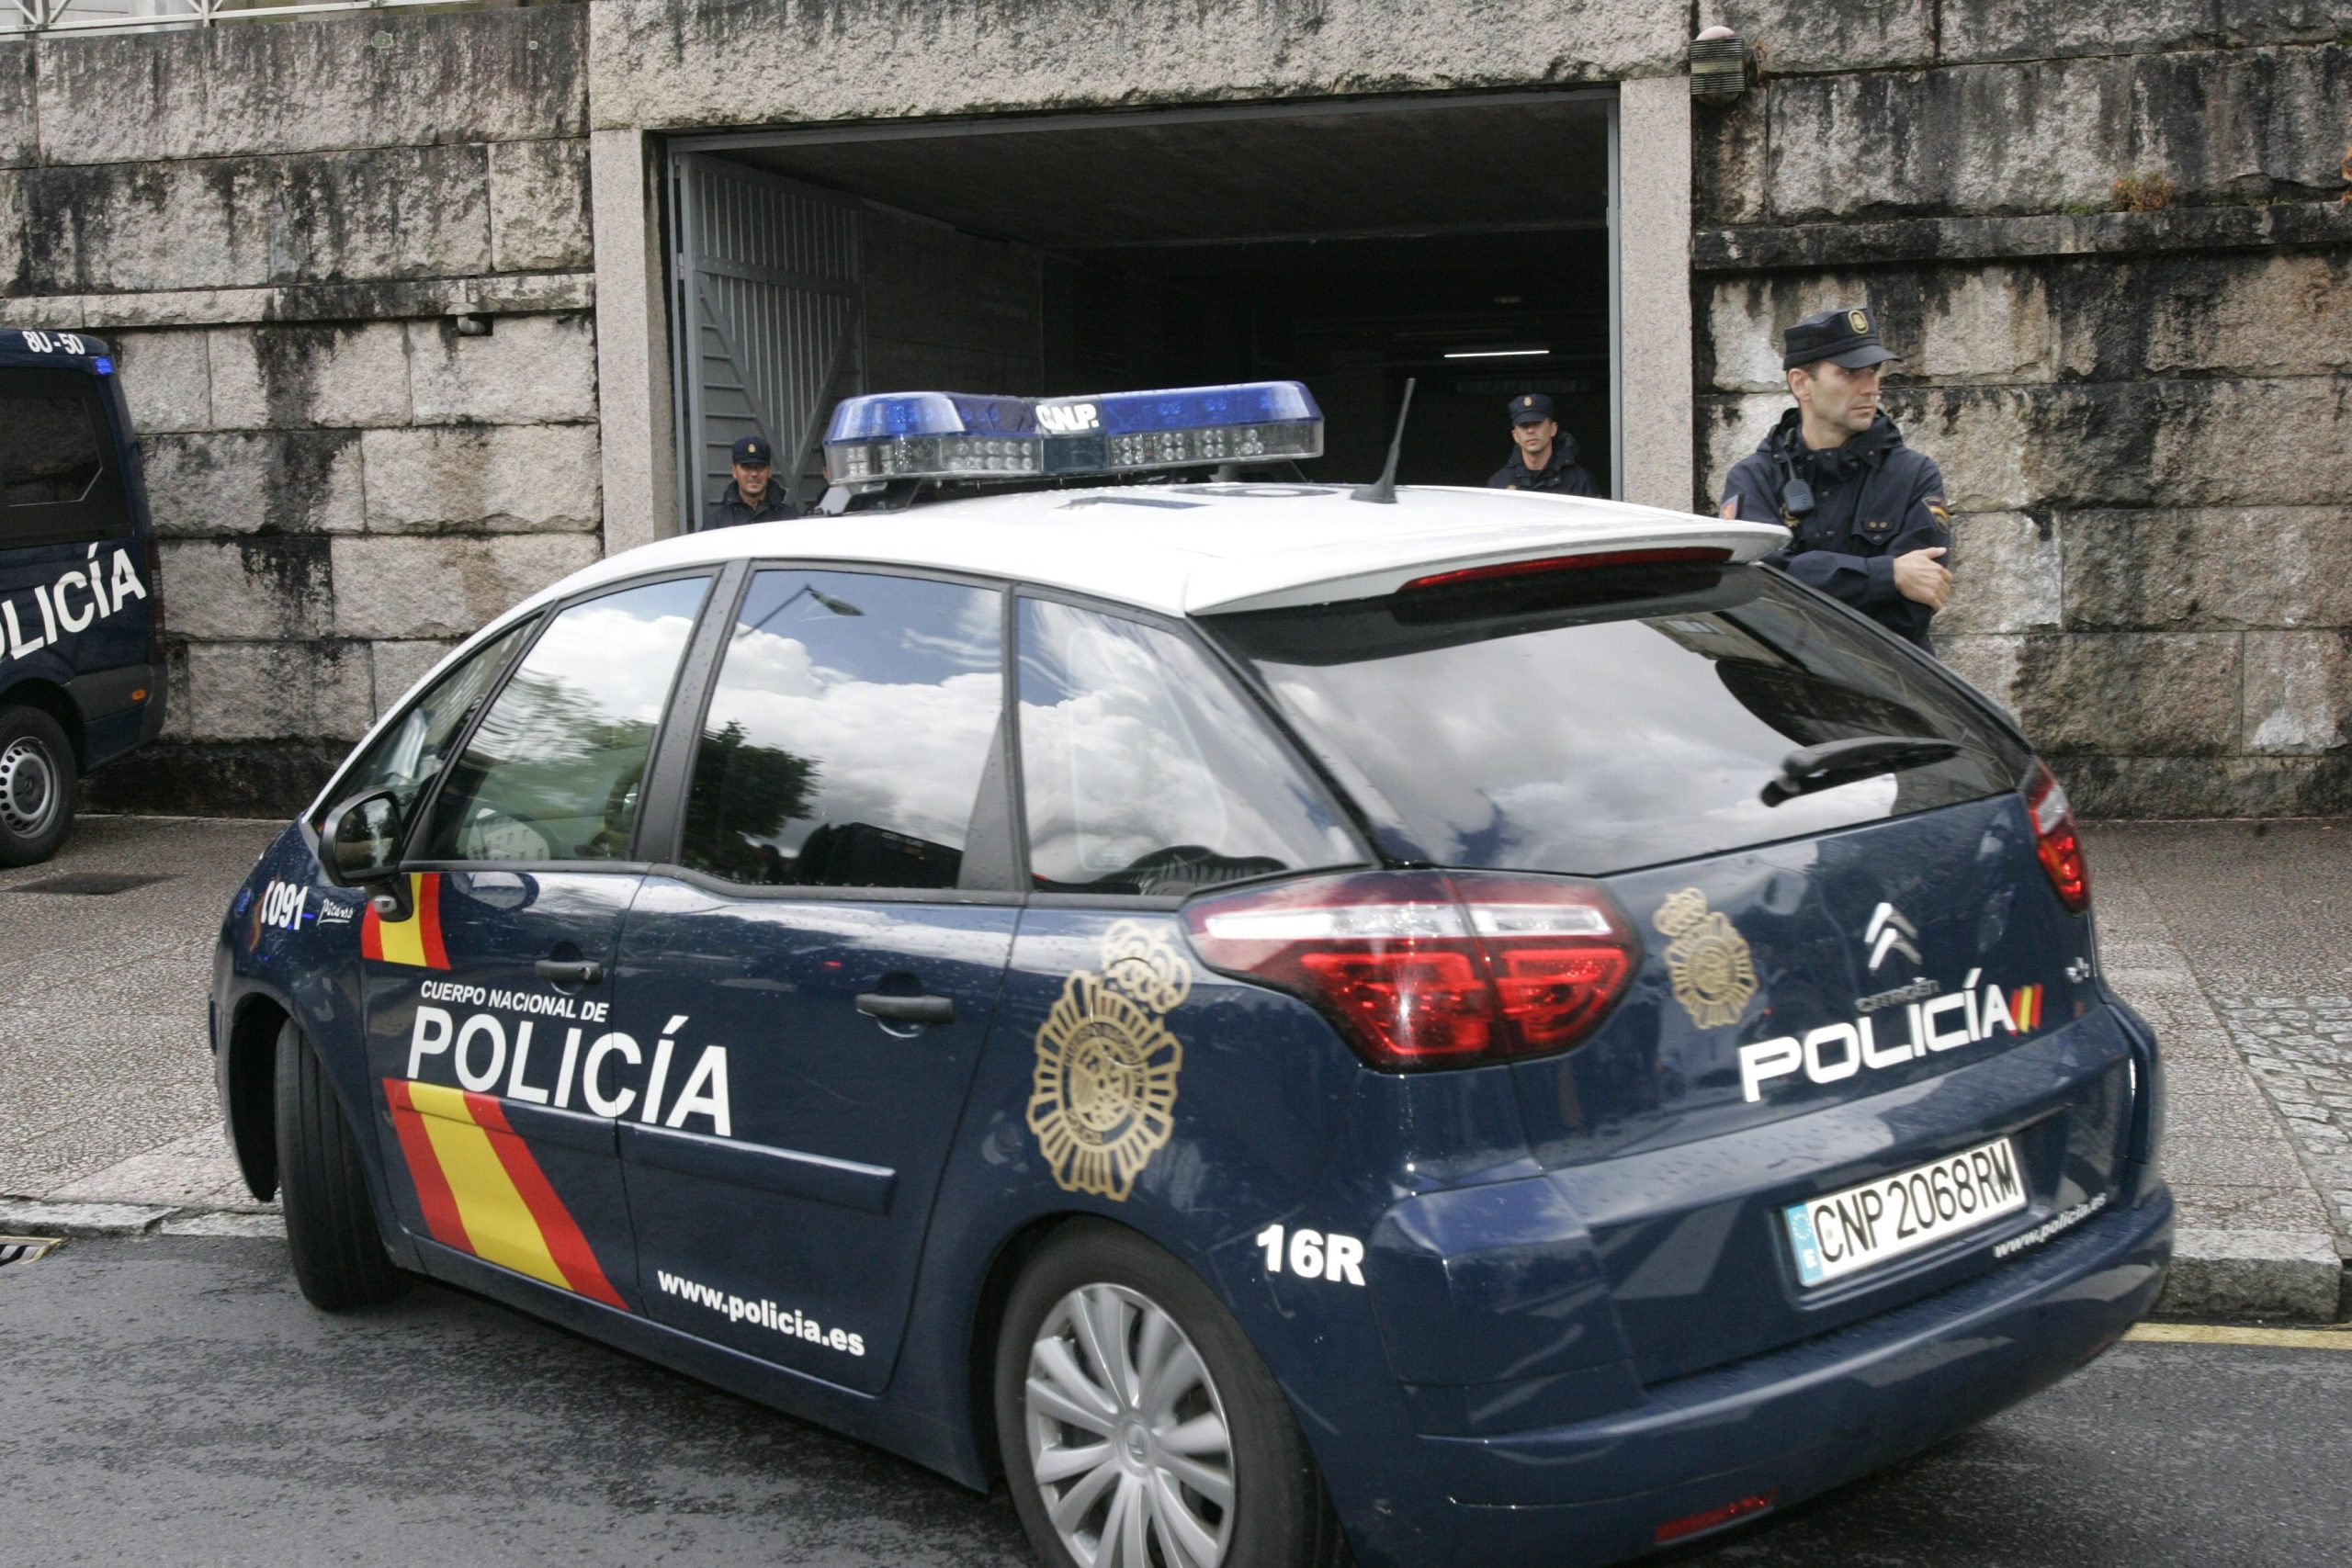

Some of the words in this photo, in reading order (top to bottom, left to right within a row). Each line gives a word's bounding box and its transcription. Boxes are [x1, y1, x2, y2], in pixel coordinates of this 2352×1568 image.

[0, 542, 146, 660] LICÍA
[260, 880, 309, 931] 1091
[421, 980, 486, 1006] CUERPO
[489, 989, 577, 1019] NACIONAL
[581, 1000, 610, 1022] DE
[1739, 968, 2016, 1103] POLICÍA
[407, 1006, 732, 1137] POLICÍA
[1256, 1224, 1366, 1286] 16R
[1804, 1248, 1817, 1269] E
[658, 1270, 865, 1357] www.policia.es
